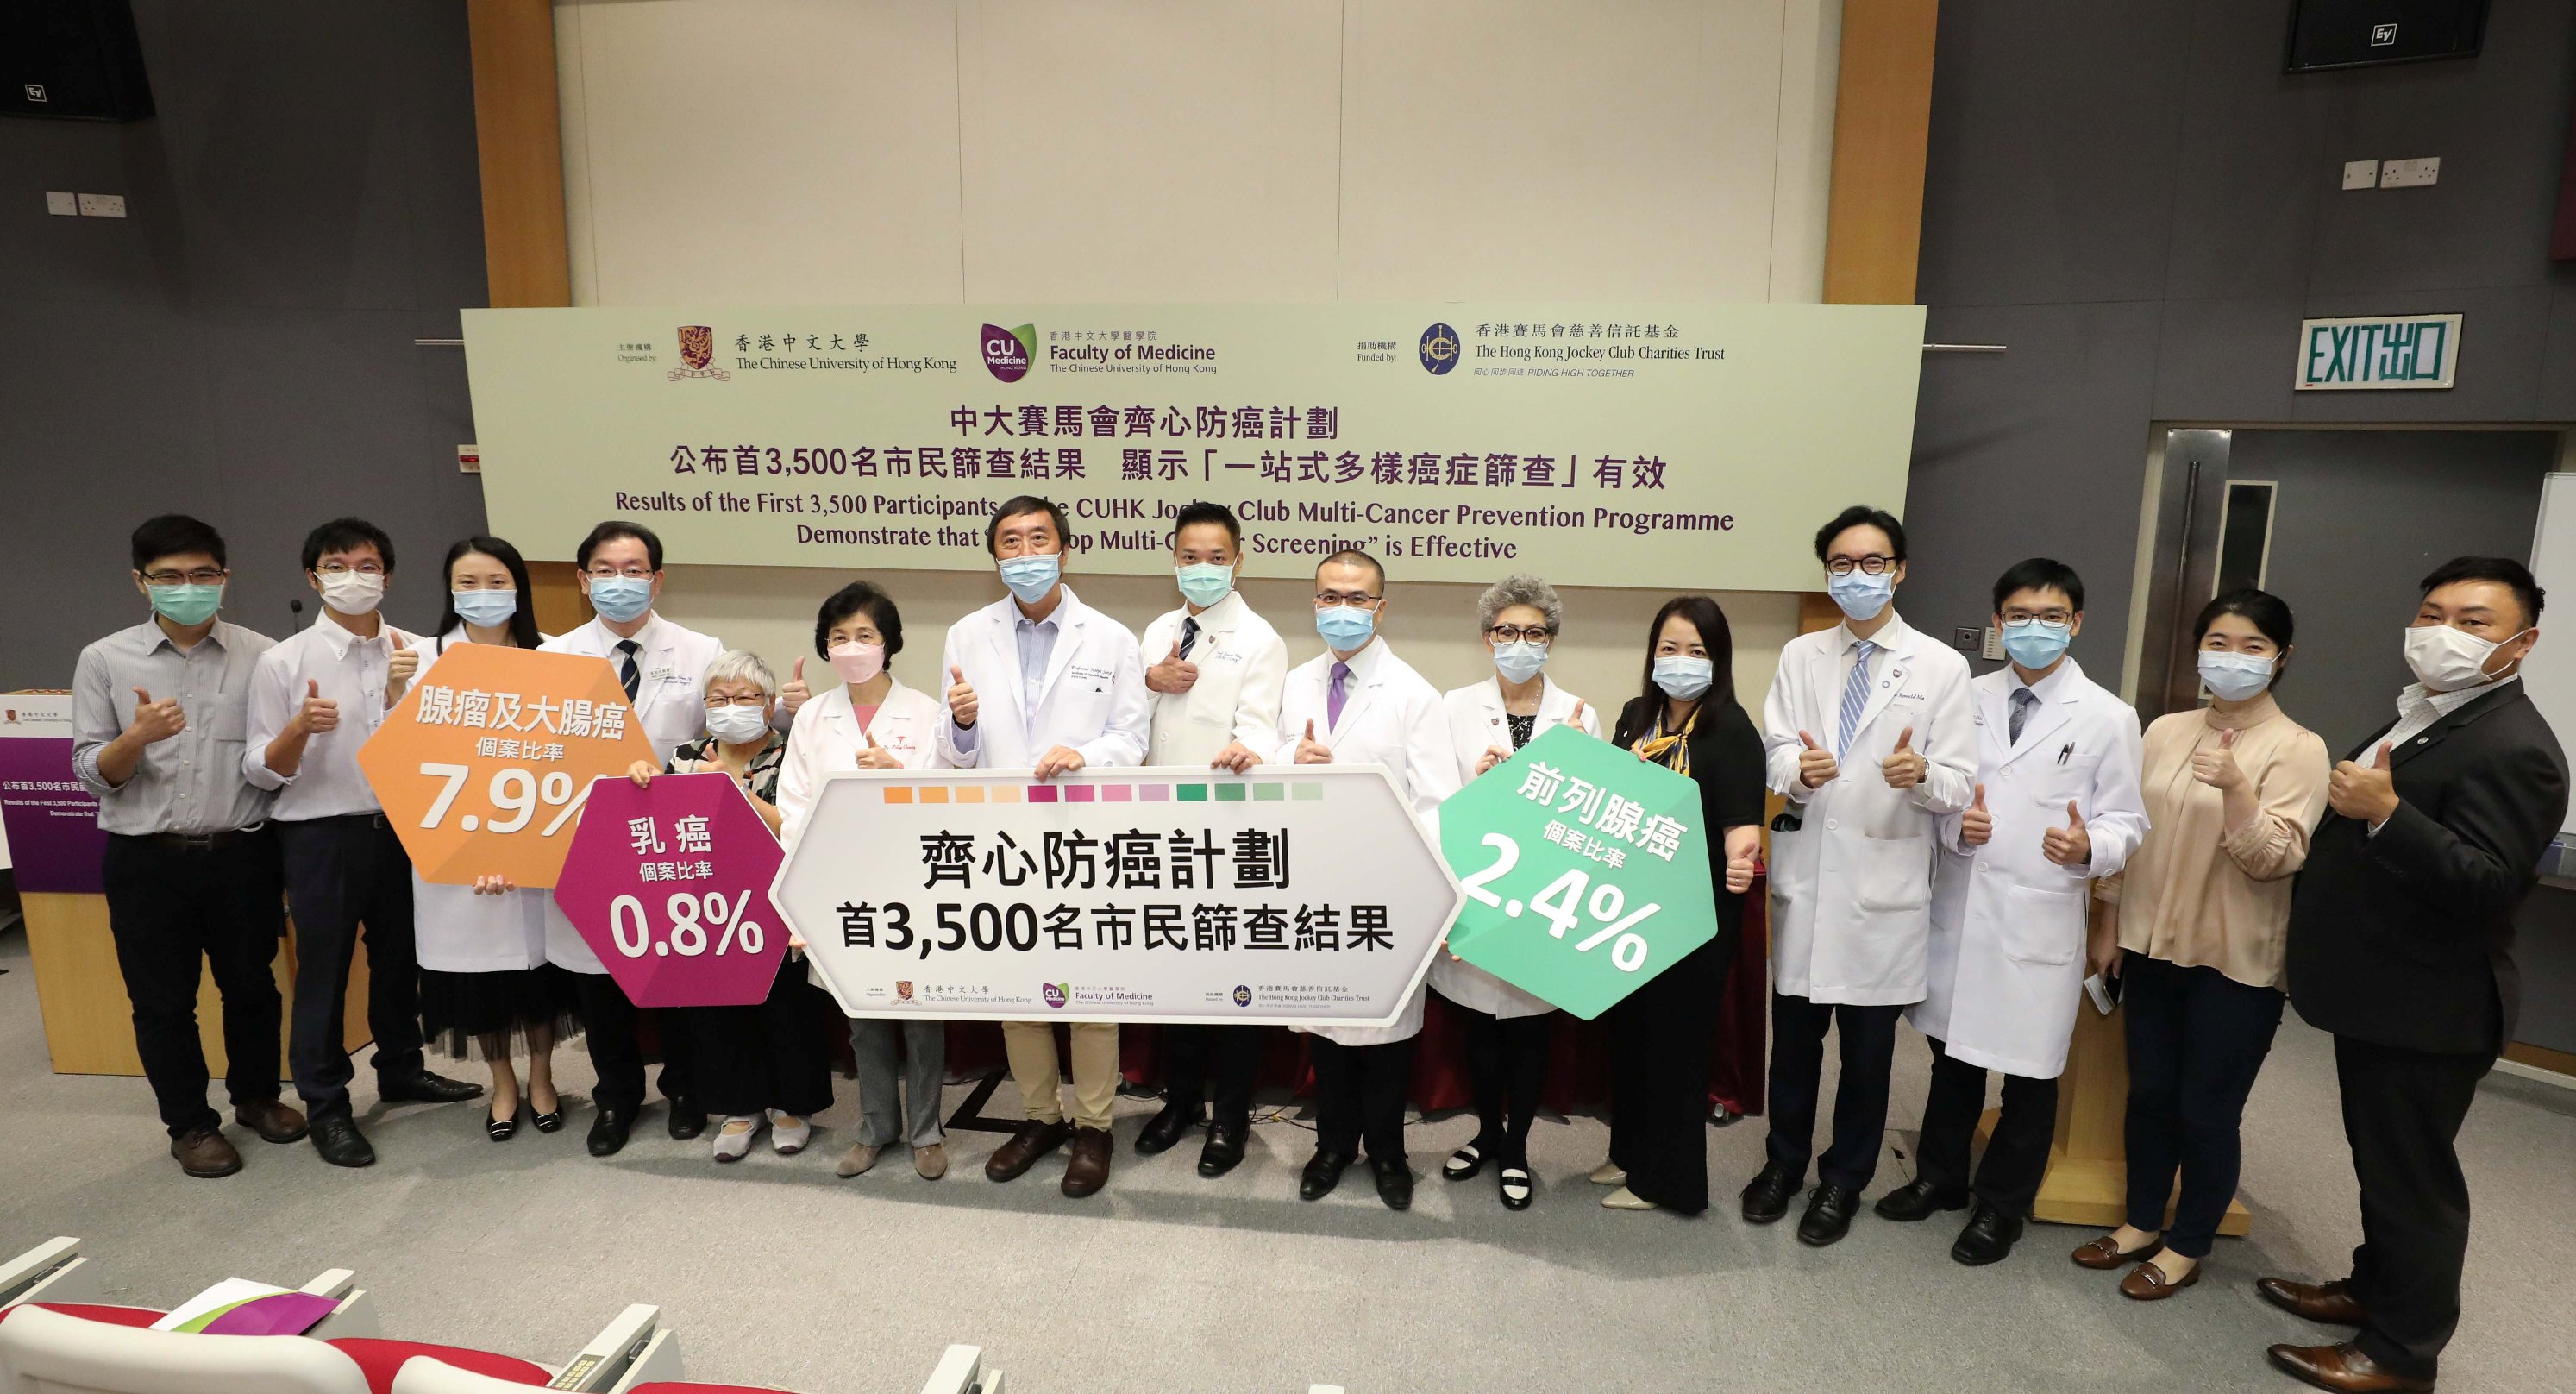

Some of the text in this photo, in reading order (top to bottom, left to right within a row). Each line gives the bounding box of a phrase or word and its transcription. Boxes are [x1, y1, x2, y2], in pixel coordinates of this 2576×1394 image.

[1050, 331, 1157, 341] 香港中文大學醫學院
[1476, 323, 1680, 338] 香港賽馬會慈善信託基金
[735, 333, 869, 353] 香港中文大學
[987, 339, 1015, 356] CU
[1050, 344, 1215, 363] Faculty of Medicine
[1357, 341, 1397, 351] 捐助機構
[1475, 345, 1725, 361] The Hong Kong Jockey Club Charities Trust
[2306, 322, 2446, 382] EXIT 出口
[735, 357, 957, 374] The Chinese University of Hong Kong
[987, 356, 1027, 365] Medicine
[1357, 353, 1384, 361] Funded
[1050, 364, 1217, 374] The Chinese University of Hong Kong
[1527, 368, 1558, 377] RIDING
[1561, 368, 1584, 377] HIGH
[1587, 369, 1634, 378] TOGETHER
[950, 405, 1338, 440] 中大賽馬會齊心防癌計劃
[670, 445, 1087, 480] 公布首3,500名市民篩查結果
[616, 491, 686, 512] Results
[692, 491, 713, 512] of
[718, 492, 751, 512] the
[757, 492, 805, 513] First
[810, 494, 867, 517] 3,500
[874, 494, 998, 519] Participants
[1075, 498, 1146, 519] CUHK
[1238, 499, 1291, 522] Club
[1298, 501, 1450, 524] Multi-Cancer
[1457, 504, 1586, 528] Prevention
[1594, 507, 1734, 535] Programme
[797, 524, 931, 547] Demonstrate
[937, 525, 980, 548] that
[1386, 534, 1403, 556] is
[1411, 535, 1517, 559] Effective
[415, 684, 628, 742] 腺瘤及大腸癌
[475, 737, 565, 763] 個案比率
[1516, 761, 1688, 863] 前列腺癌
[1543, 819, 1627, 870] 個案比率
[919, 828, 1290, 889] 齊心防癌計劃
[639, 860, 714, 882] 個案比率
[1460, 832, 1662, 972] 2.4%
[609, 889, 765, 959] 0.8%
[835, 901, 1395, 960] 首3,500名市民篩查結果
[924, 985, 990, 994] 香港中文大學
[1075, 992, 1103, 1001] Faculty
